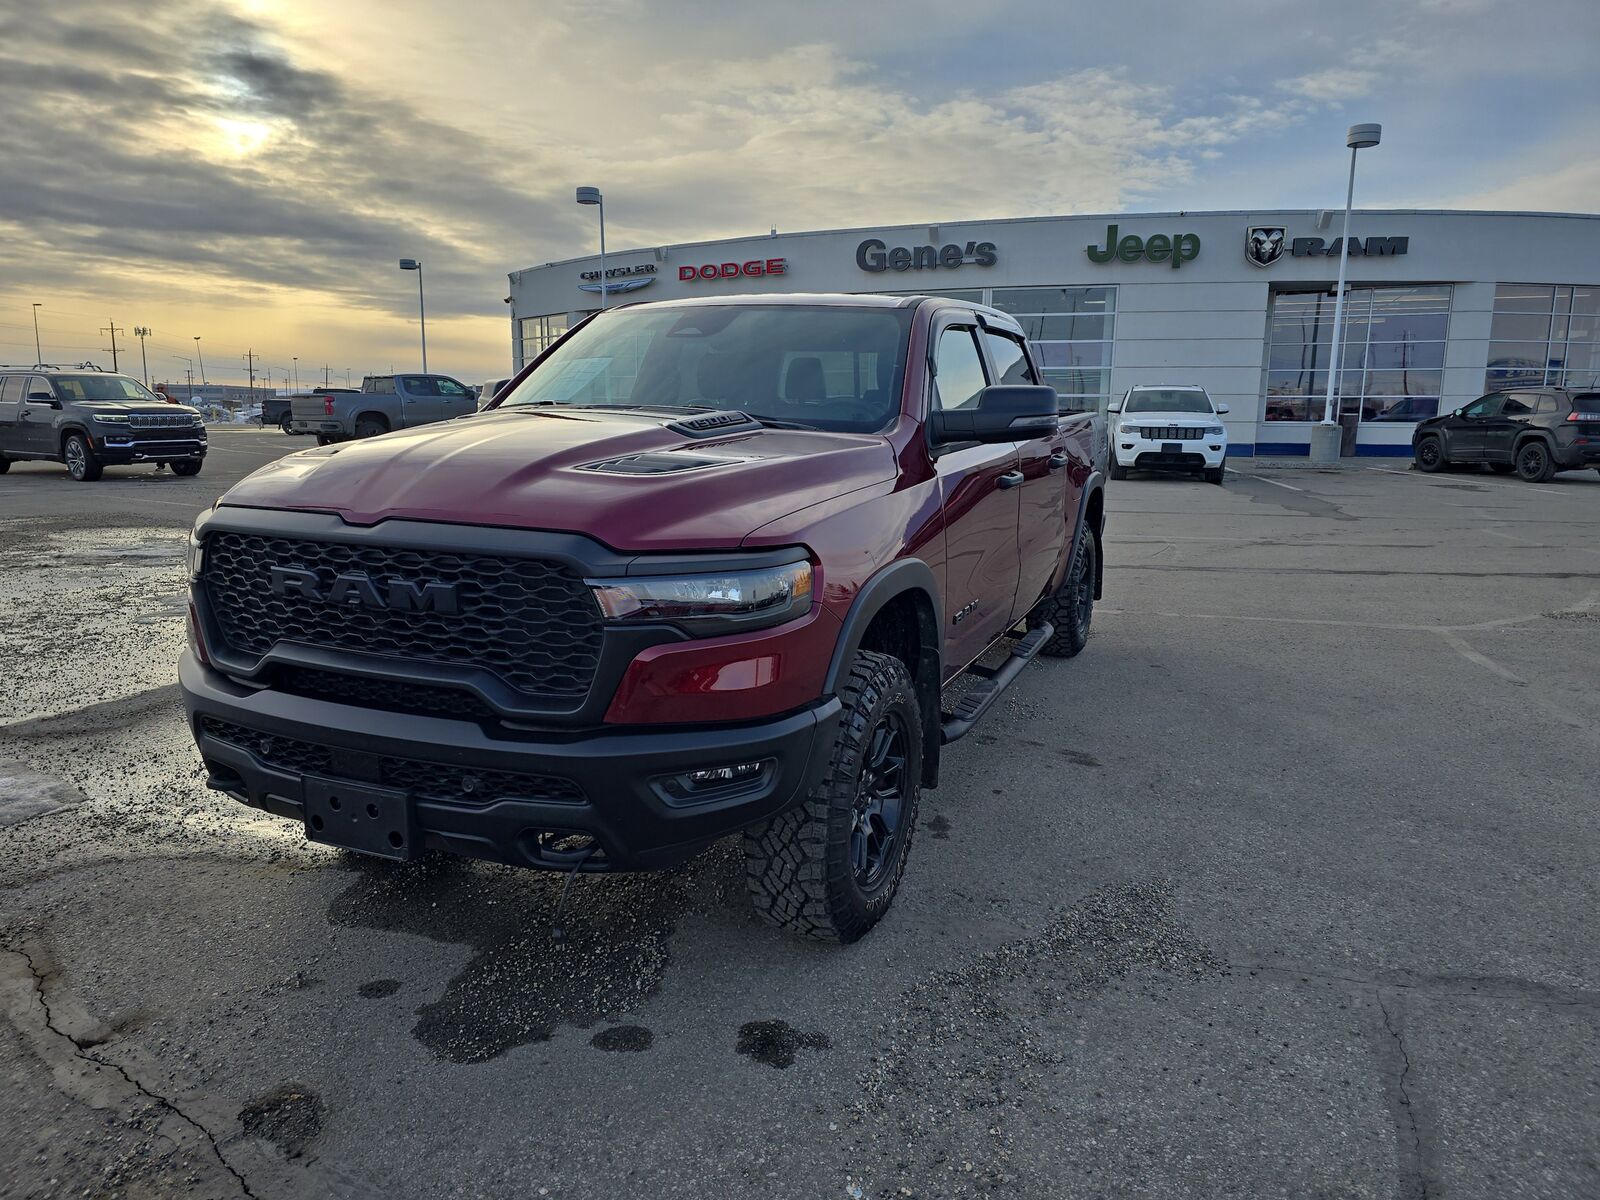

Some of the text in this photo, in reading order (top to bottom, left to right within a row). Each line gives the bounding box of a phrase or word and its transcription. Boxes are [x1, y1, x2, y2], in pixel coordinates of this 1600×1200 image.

[856, 239, 998, 272] Gene's
[1087, 225, 1200, 268] Jeep
[1293, 236, 1409, 257] RAM
[580, 264, 656, 280] CHRYSLER
[678, 258, 785, 281] DODGE
[270, 566, 462, 612] RAM
